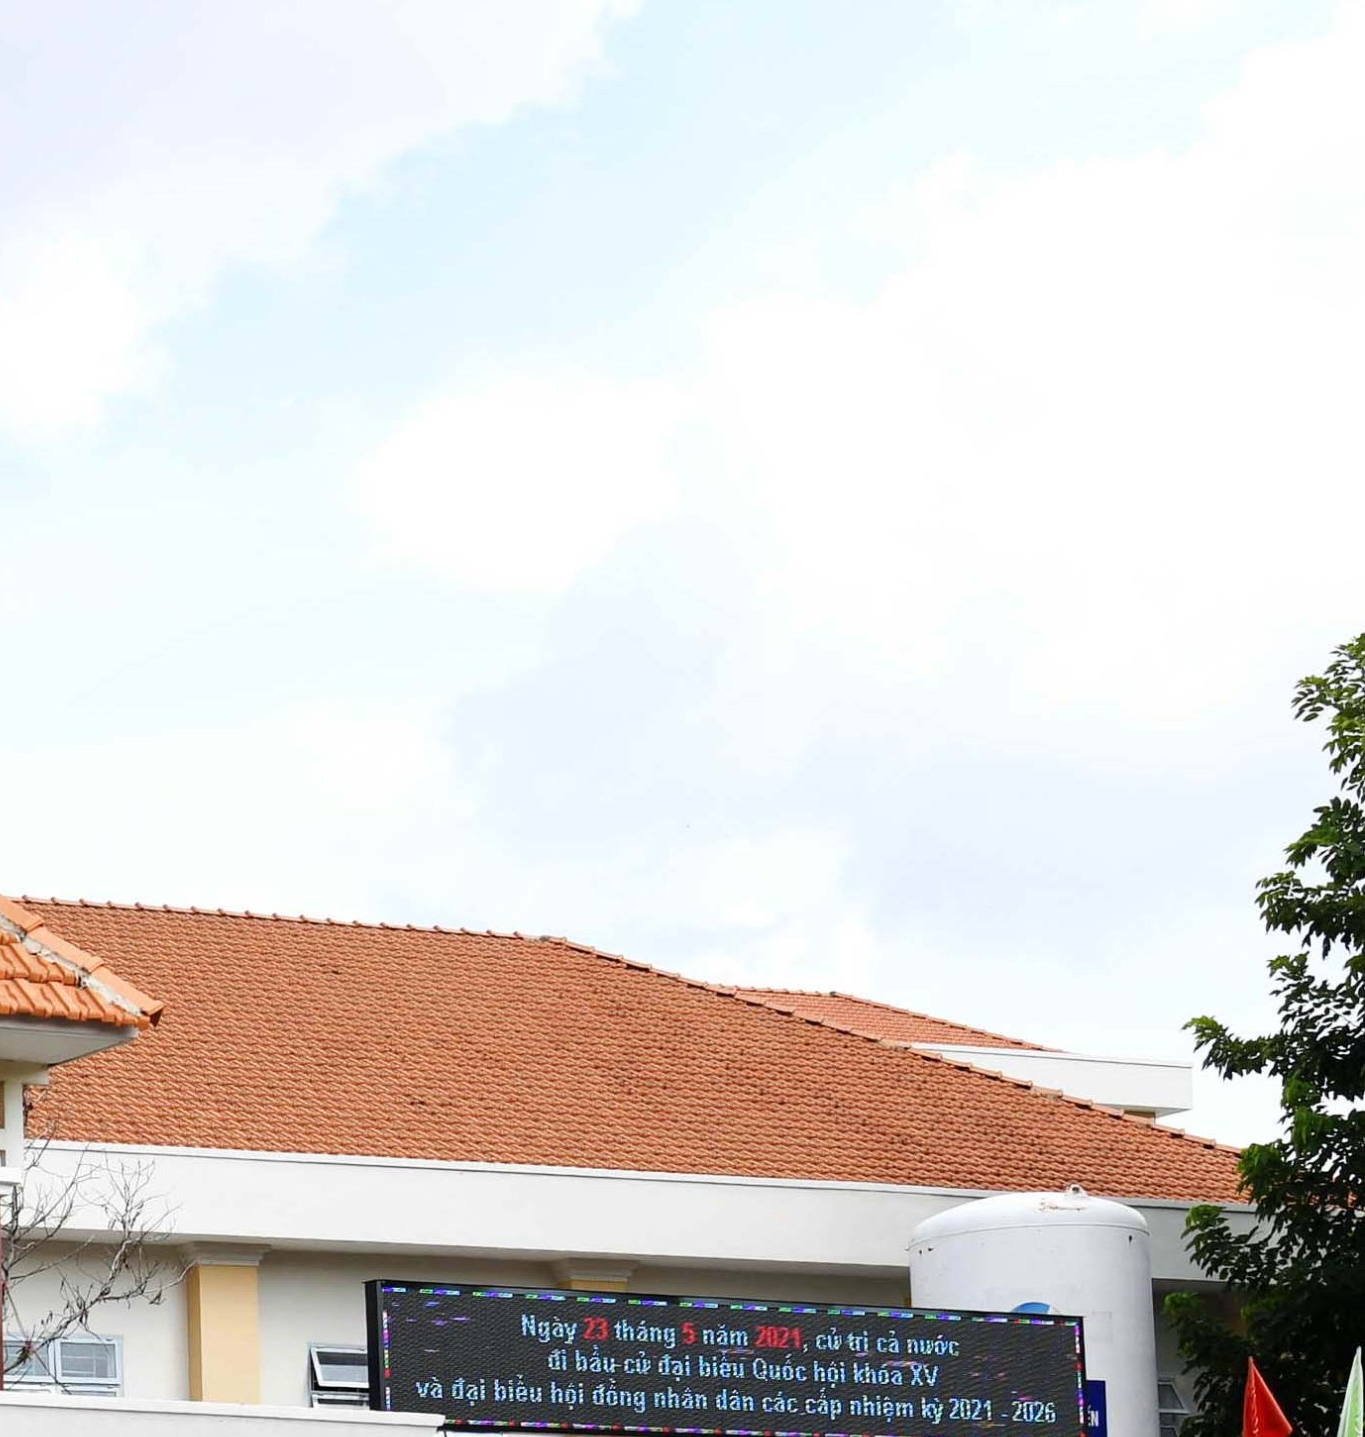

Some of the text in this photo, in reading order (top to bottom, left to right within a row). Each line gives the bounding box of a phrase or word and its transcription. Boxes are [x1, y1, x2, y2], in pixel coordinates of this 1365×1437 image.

[521, 1313, 577, 1344] Ngày
[583, 1317, 609, 1341] 23
[615, 1317, 676, 1348] tháng
[681, 1322, 697, 1344] 5
[703, 1323, 749, 1347] năm
[755, 1326, 808, 1353] 2021,
[816, 1328, 843, 1351] cử
[876, 1330, 900, 1353] cả
[907, 1333, 959, 1357] nước
[548, 1350, 568, 1371] đi
[623, 1352, 651, 1374] cử
[658, 1354, 692, 1382] đại
[699, 1351, 745, 1379] biểu
[752, 1354, 807, 1383] Quốc
[813, 1361, 846, 1389] hội
[854, 1362, 903, 1385] khóa
[910, 1365, 940, 1388] XV
[415, 1376, 444, 1400] và
[451, 1377, 487, 1406] đại
[495, 1374, 542, 1404] biểu
[551, 1382, 585, 1411] hội
[592, 1378, 646, 1413] đồng
[654, 1386, 708, 1411] nhân
[716, 1388, 755, 1413] dân
[763, 1391, 799, 1414] các
[805, 1387, 843, 1419] cấp
[850, 1395, 914, 1423] nhiệm
[949, 1398, 993, 1422] 2021
[1012, 1400, 1056, 1424] 2026
